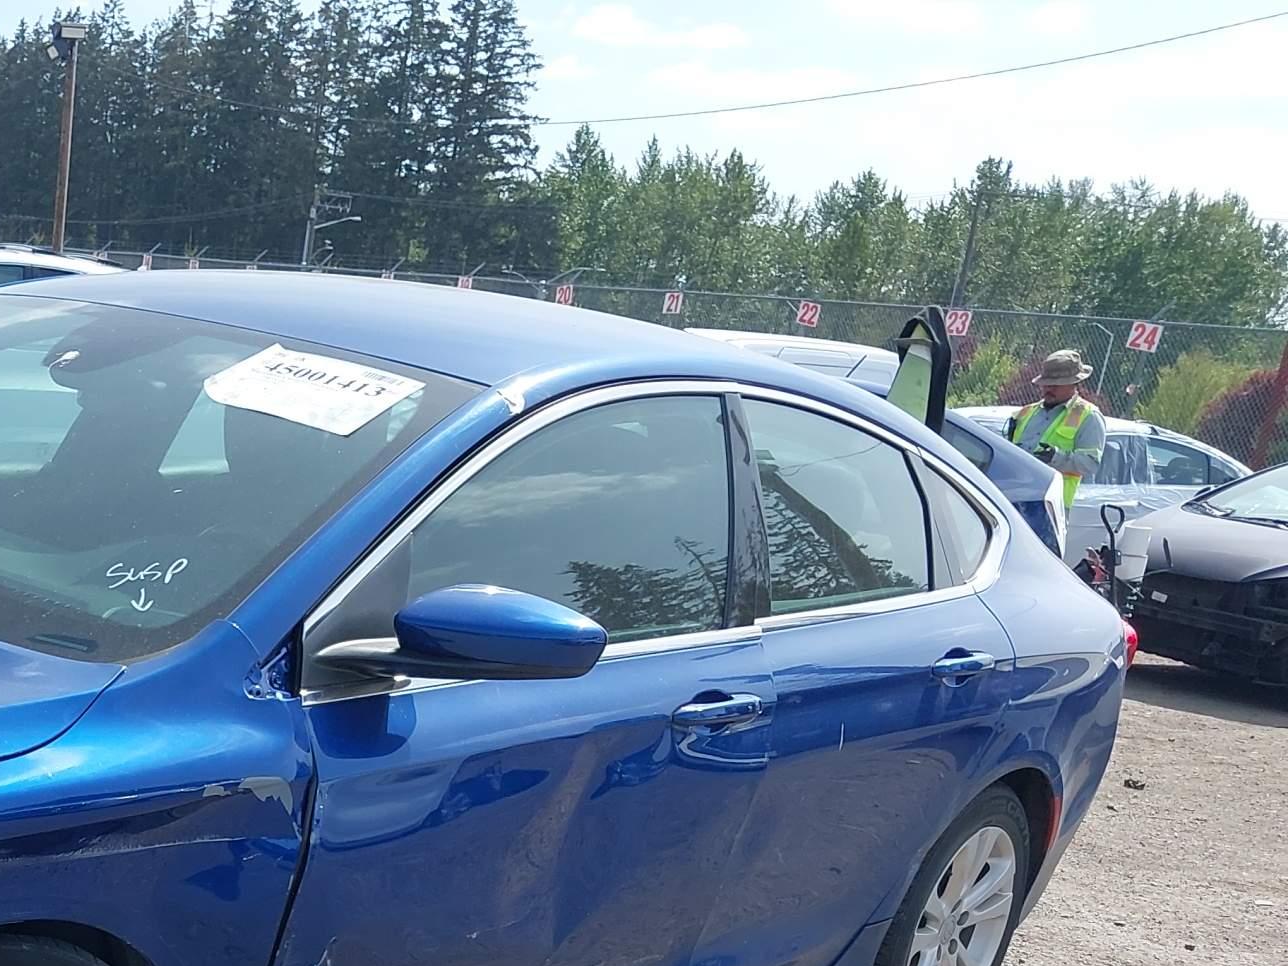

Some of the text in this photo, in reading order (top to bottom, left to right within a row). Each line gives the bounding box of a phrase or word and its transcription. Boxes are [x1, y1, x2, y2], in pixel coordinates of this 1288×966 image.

[557, 286, 571, 304] 20
[666, 294, 680, 312] 21
[798, 303, 819, 325] 22
[947, 311, 970, 334] 23
[1129, 323, 1159, 350] 24
[264, 363, 388, 397] 45001413
